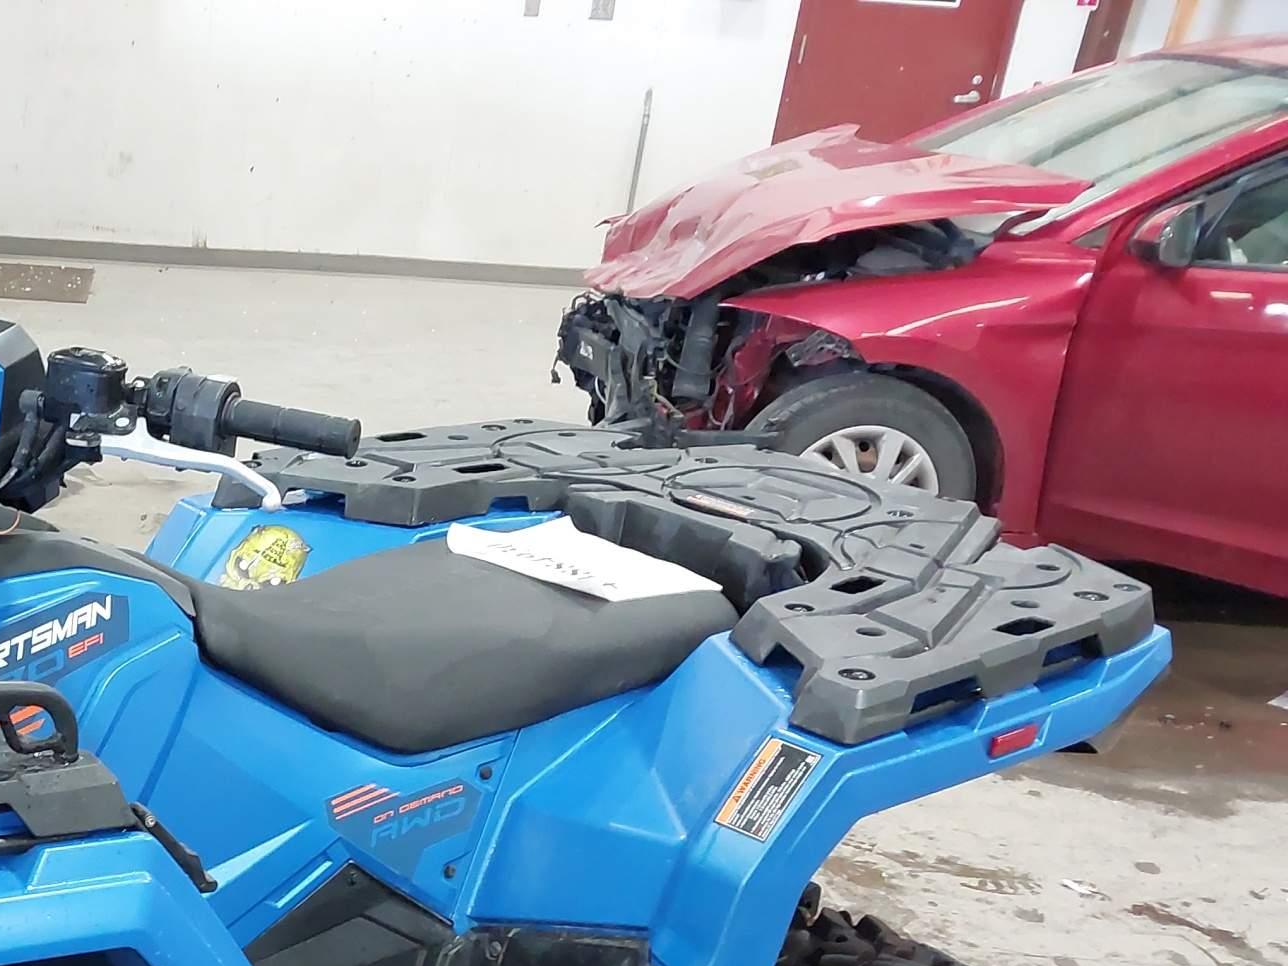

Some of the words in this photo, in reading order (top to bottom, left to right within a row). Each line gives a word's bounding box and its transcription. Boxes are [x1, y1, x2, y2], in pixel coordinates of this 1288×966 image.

[67, 632, 104, 659] EFI
[738, 759, 766, 795] WARNING
[370, 797, 465, 848] AWD
[373, 810, 394, 824] ON
[398, 784, 464, 815] DEMAND
